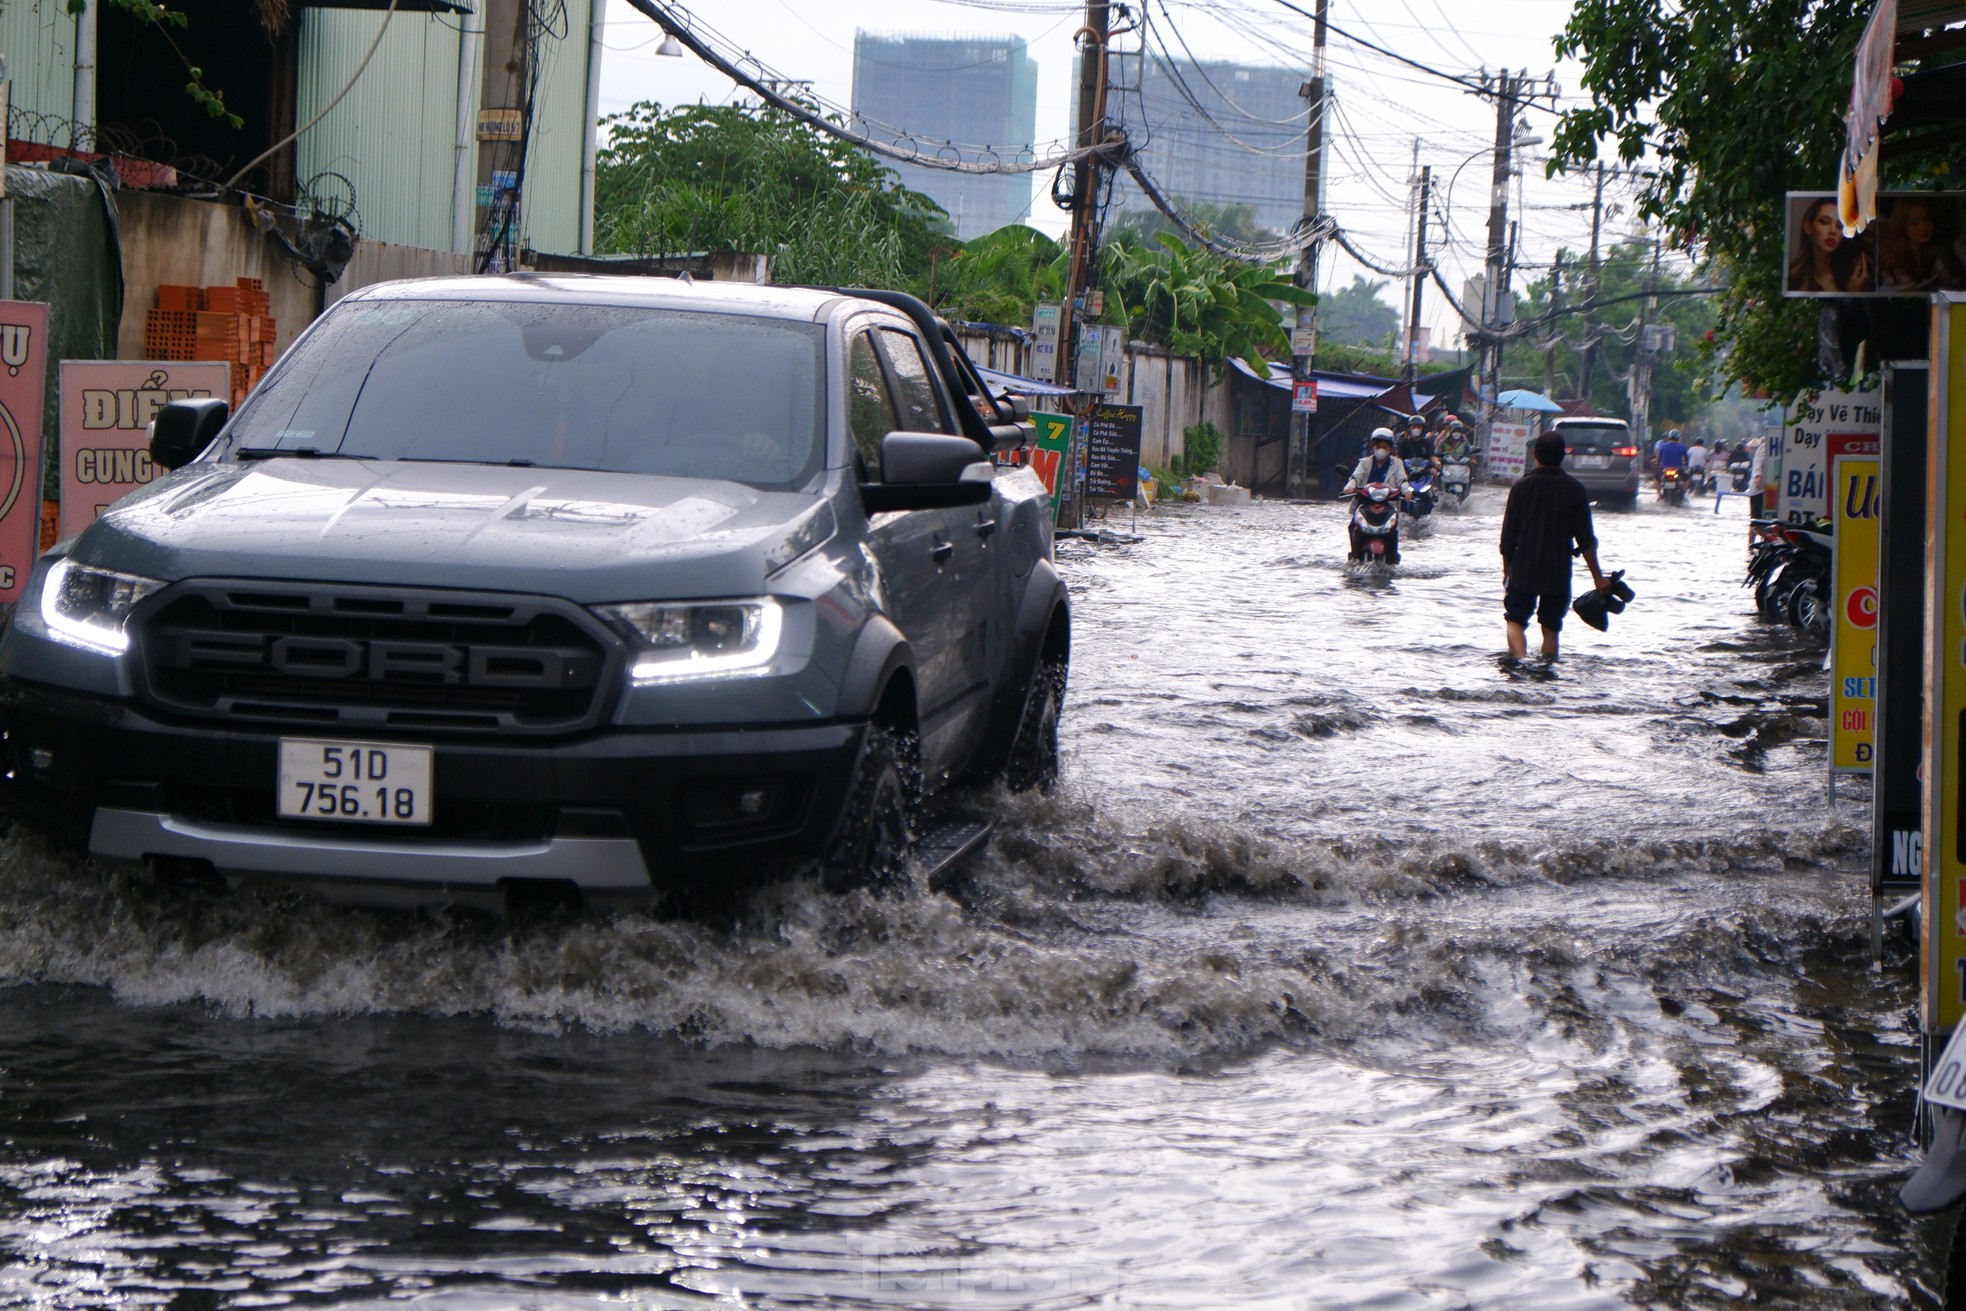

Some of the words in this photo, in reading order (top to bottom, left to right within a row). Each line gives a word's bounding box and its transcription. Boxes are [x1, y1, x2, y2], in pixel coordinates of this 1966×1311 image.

[0, 324, 31, 377] Ụ
[82, 370, 211, 430] ĐIỂ
[1830, 404, 1848, 422] Vẽ
[1794, 428, 1820, 448] Dạy
[76, 448, 154, 484] CUNG
[174, 627, 564, 688] FORD
[324, 748, 387, 781] 51D
[296, 782, 414, 819] 756.18
